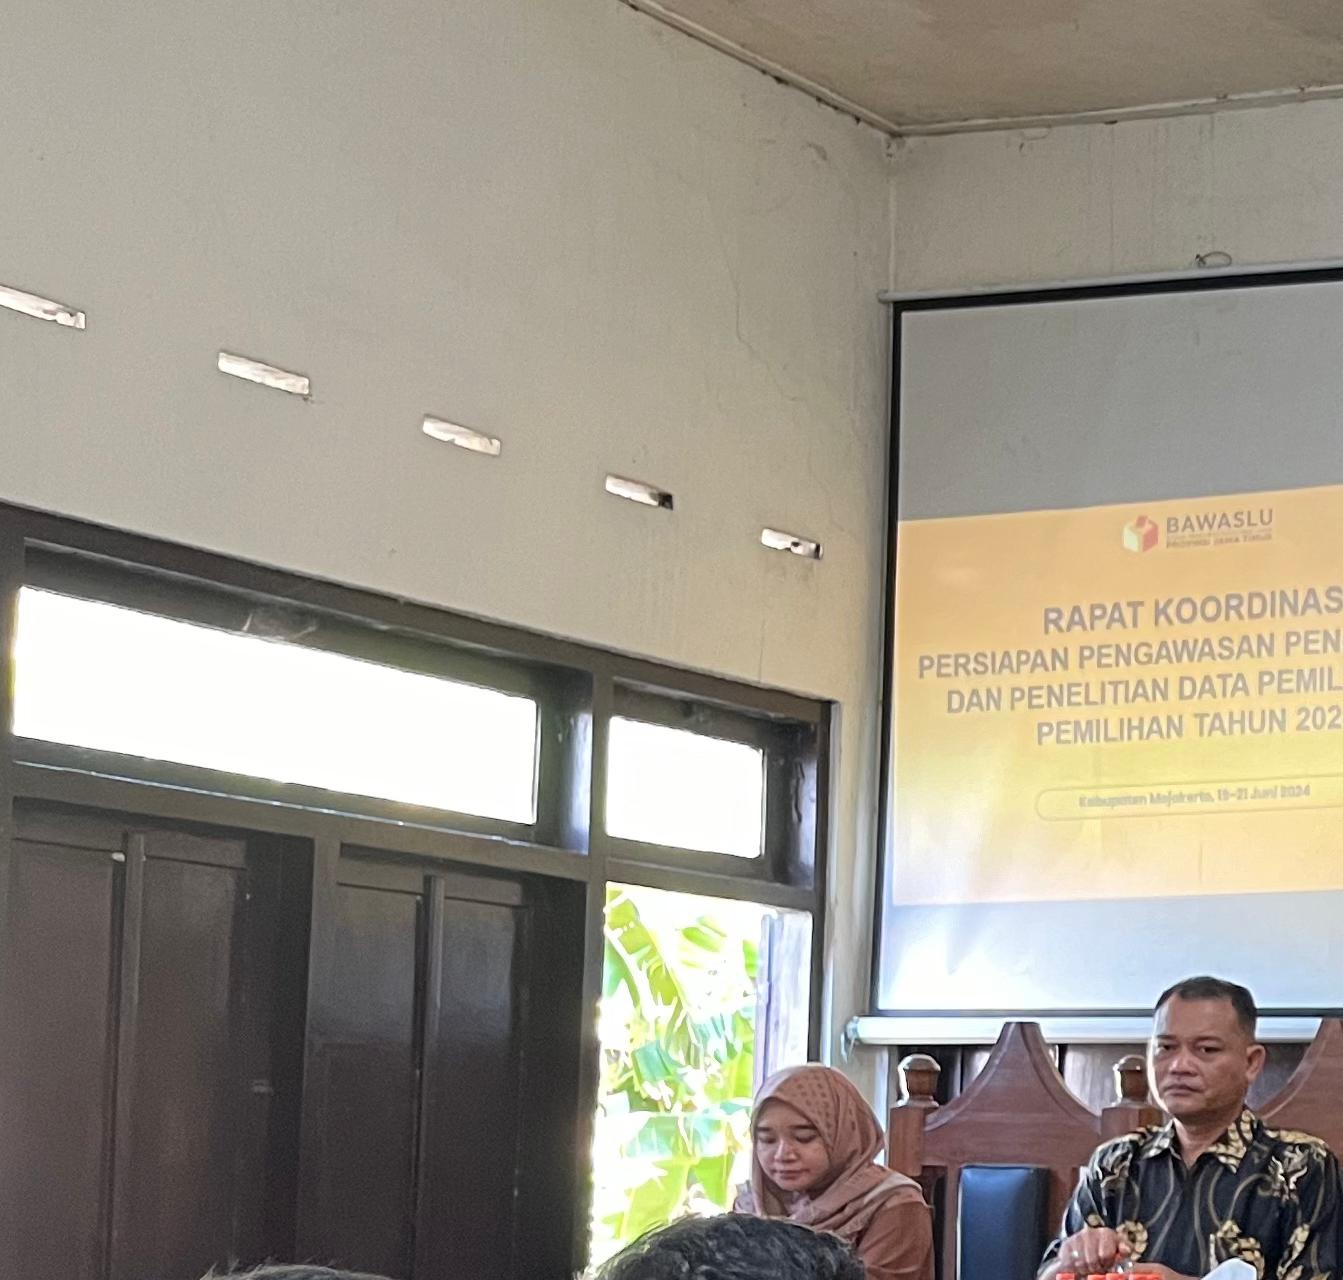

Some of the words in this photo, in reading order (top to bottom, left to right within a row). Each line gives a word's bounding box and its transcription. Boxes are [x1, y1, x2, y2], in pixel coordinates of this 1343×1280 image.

[1167, 509, 1272, 533] BAWASLU
[1043, 601, 1143, 635] RAPAT
[918, 647, 1069, 678] PERSIAPAN
[1078, 635, 1275, 669] PENGAWASAN
[947, 688, 1001, 713] DAN
[1010, 677, 1169, 711] PENELITIAN
[1178, 673, 1249, 701] DATA
[1037, 715, 1183, 745] PEMILIHAN
[1194, 709, 1287, 739] TAHUN
[1079, 794, 1147, 808] Kabupaten
[1251, 786, 1277, 799] Juni
